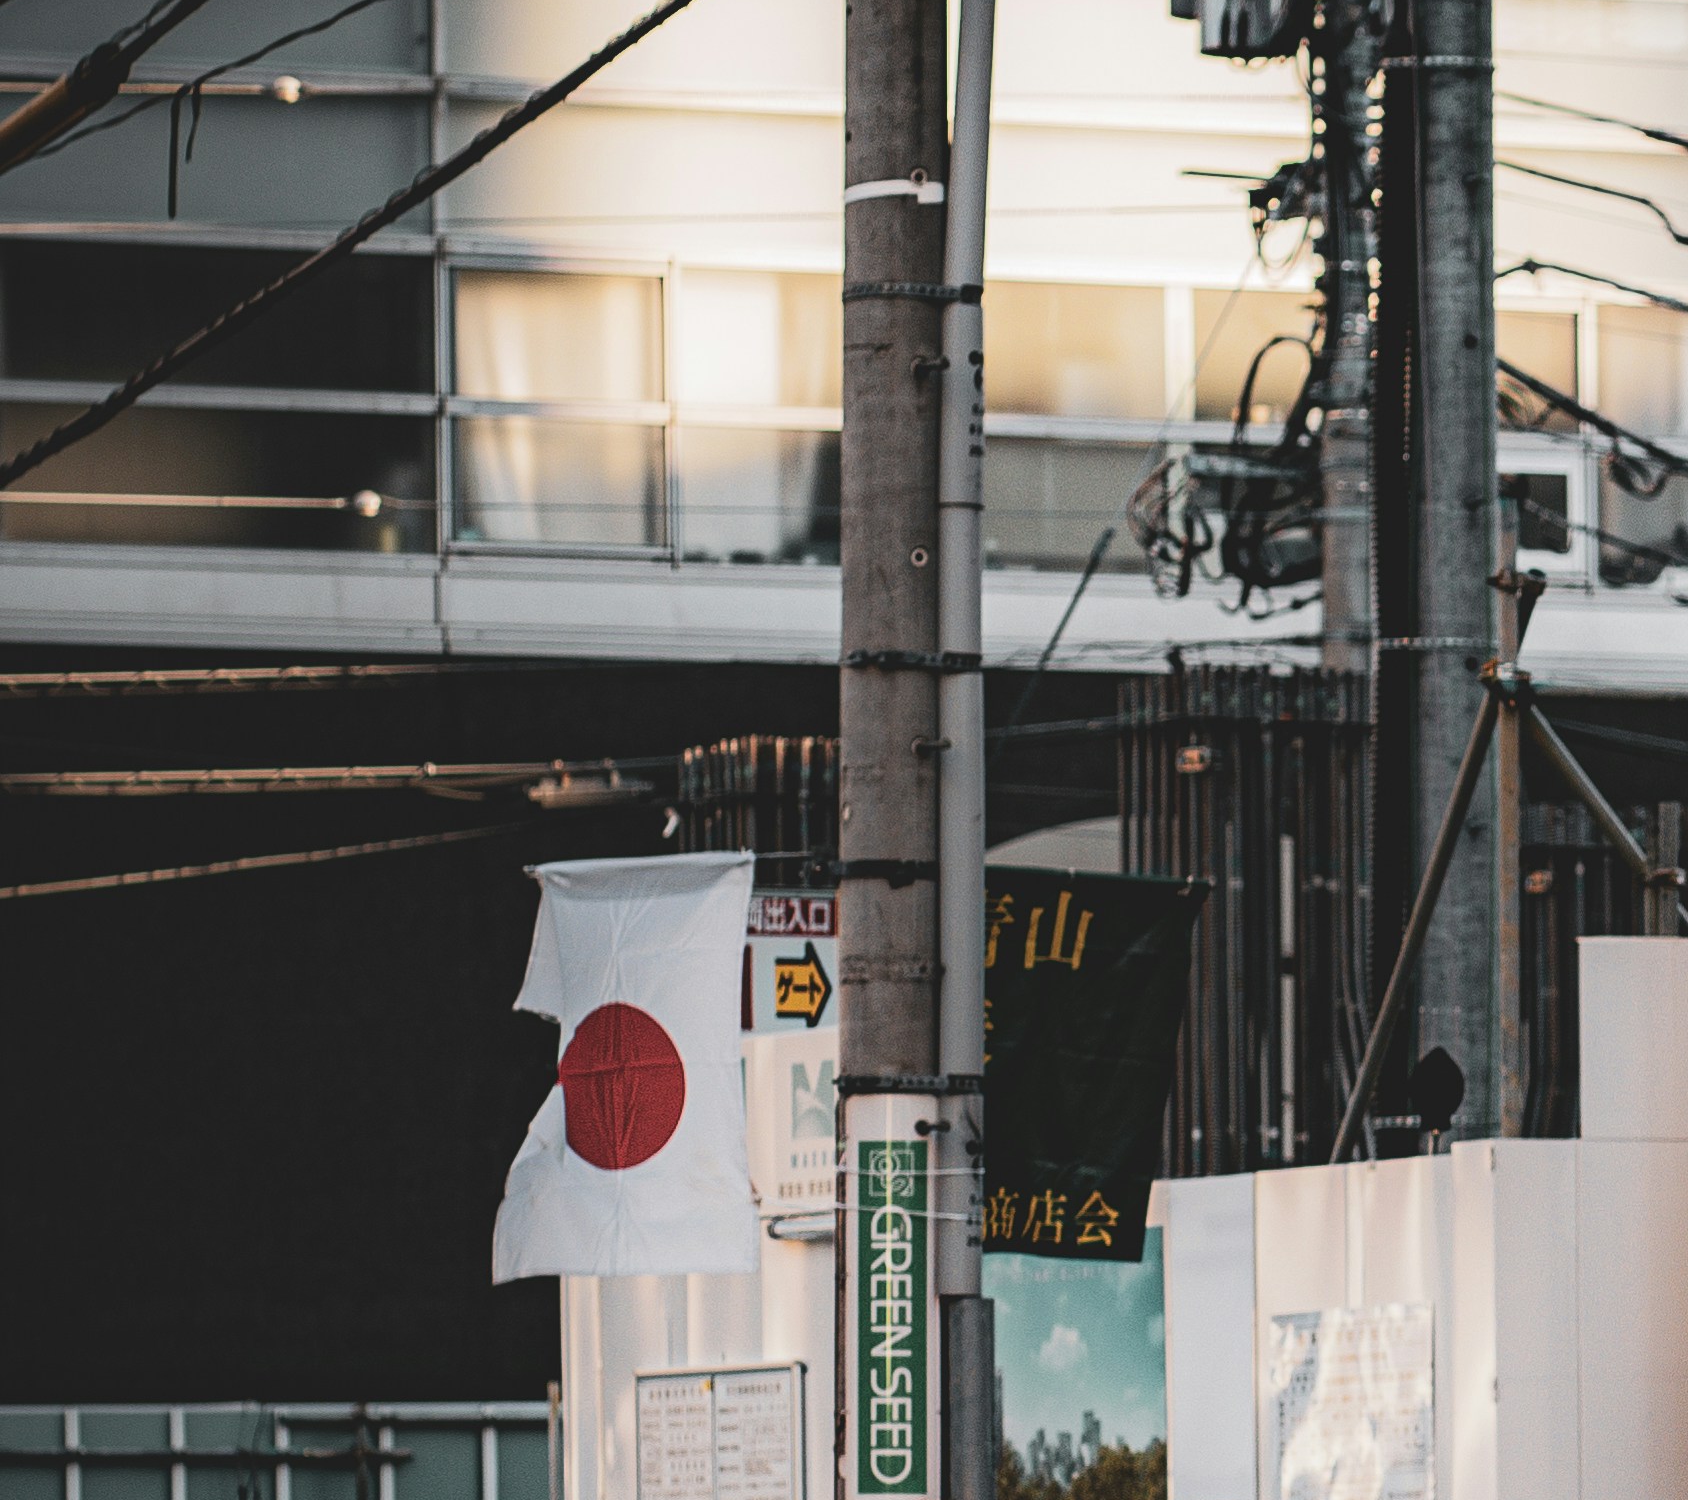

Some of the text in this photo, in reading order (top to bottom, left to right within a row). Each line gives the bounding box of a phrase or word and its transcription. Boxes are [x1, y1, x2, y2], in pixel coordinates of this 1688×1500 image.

[777, 971, 822, 1005] ゲート
[983, 1187, 1119, 1246] 商店会
[870, 1204, 912, 1485] GREEN SEED
